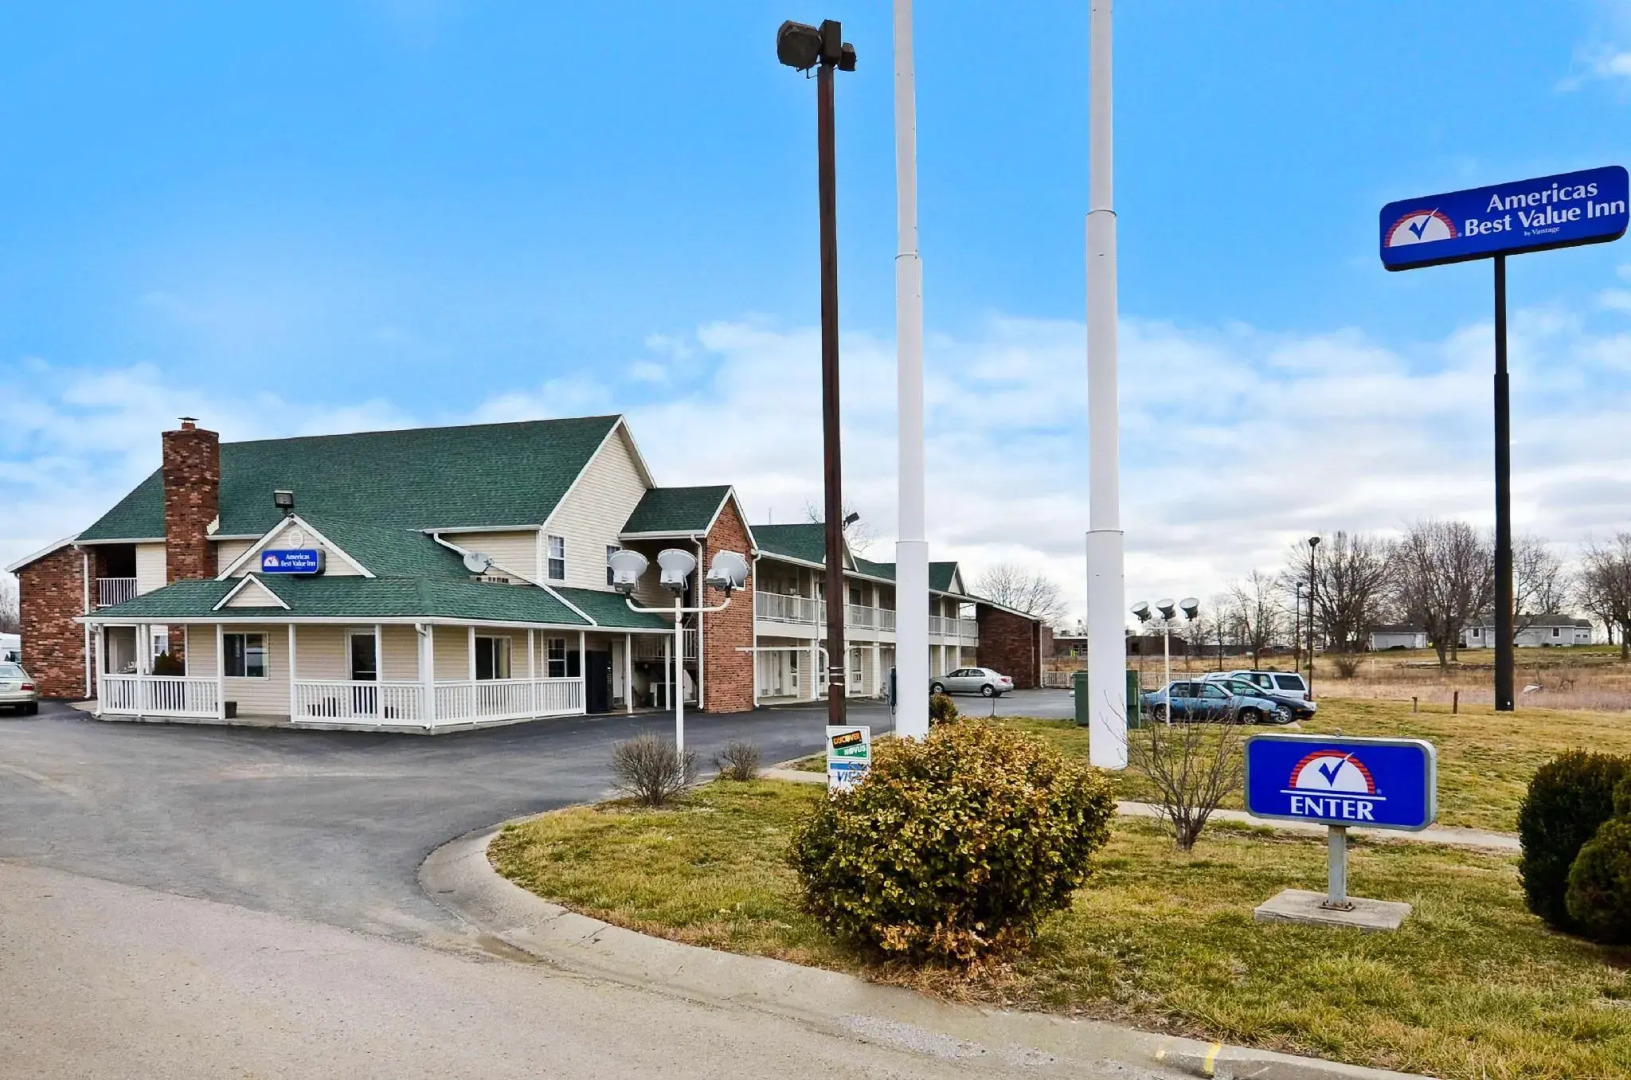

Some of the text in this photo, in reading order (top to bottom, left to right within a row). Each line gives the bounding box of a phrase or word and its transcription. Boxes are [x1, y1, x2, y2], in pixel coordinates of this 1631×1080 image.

[1486, 182, 1598, 213] Americas
[1465, 199, 1626, 237] Best Value Inn
[1531, 226, 1560, 235] Vantage
[1290, 796, 1375, 821] ENTER
